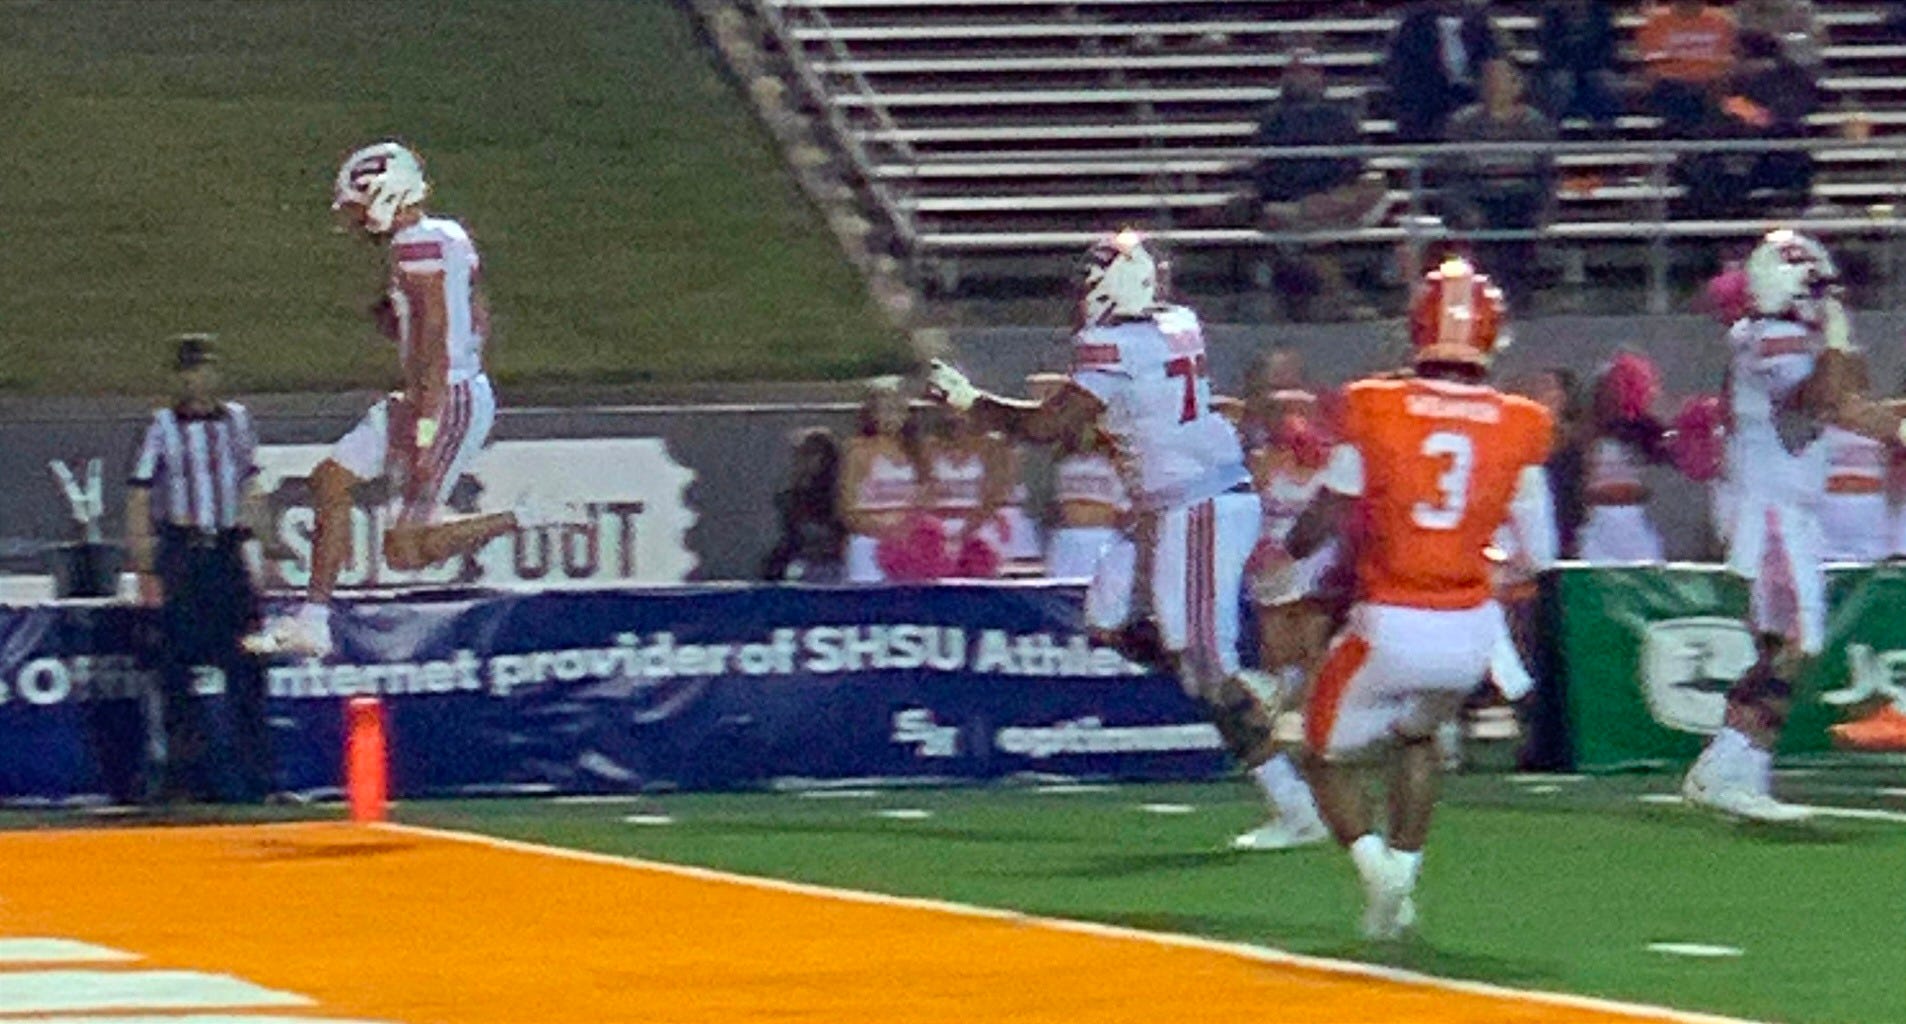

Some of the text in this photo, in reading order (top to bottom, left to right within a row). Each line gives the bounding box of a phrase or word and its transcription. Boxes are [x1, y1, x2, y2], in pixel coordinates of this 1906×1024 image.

[1163, 354, 1207, 425] 7
[1410, 431, 1472, 530] 3
[266, 648, 482, 698] nternet
[490, 631, 732, 696] provider
[739, 628, 796, 675] of
[803, 624, 967, 673] SHSU
[972, 629, 1148, 678] Athle
